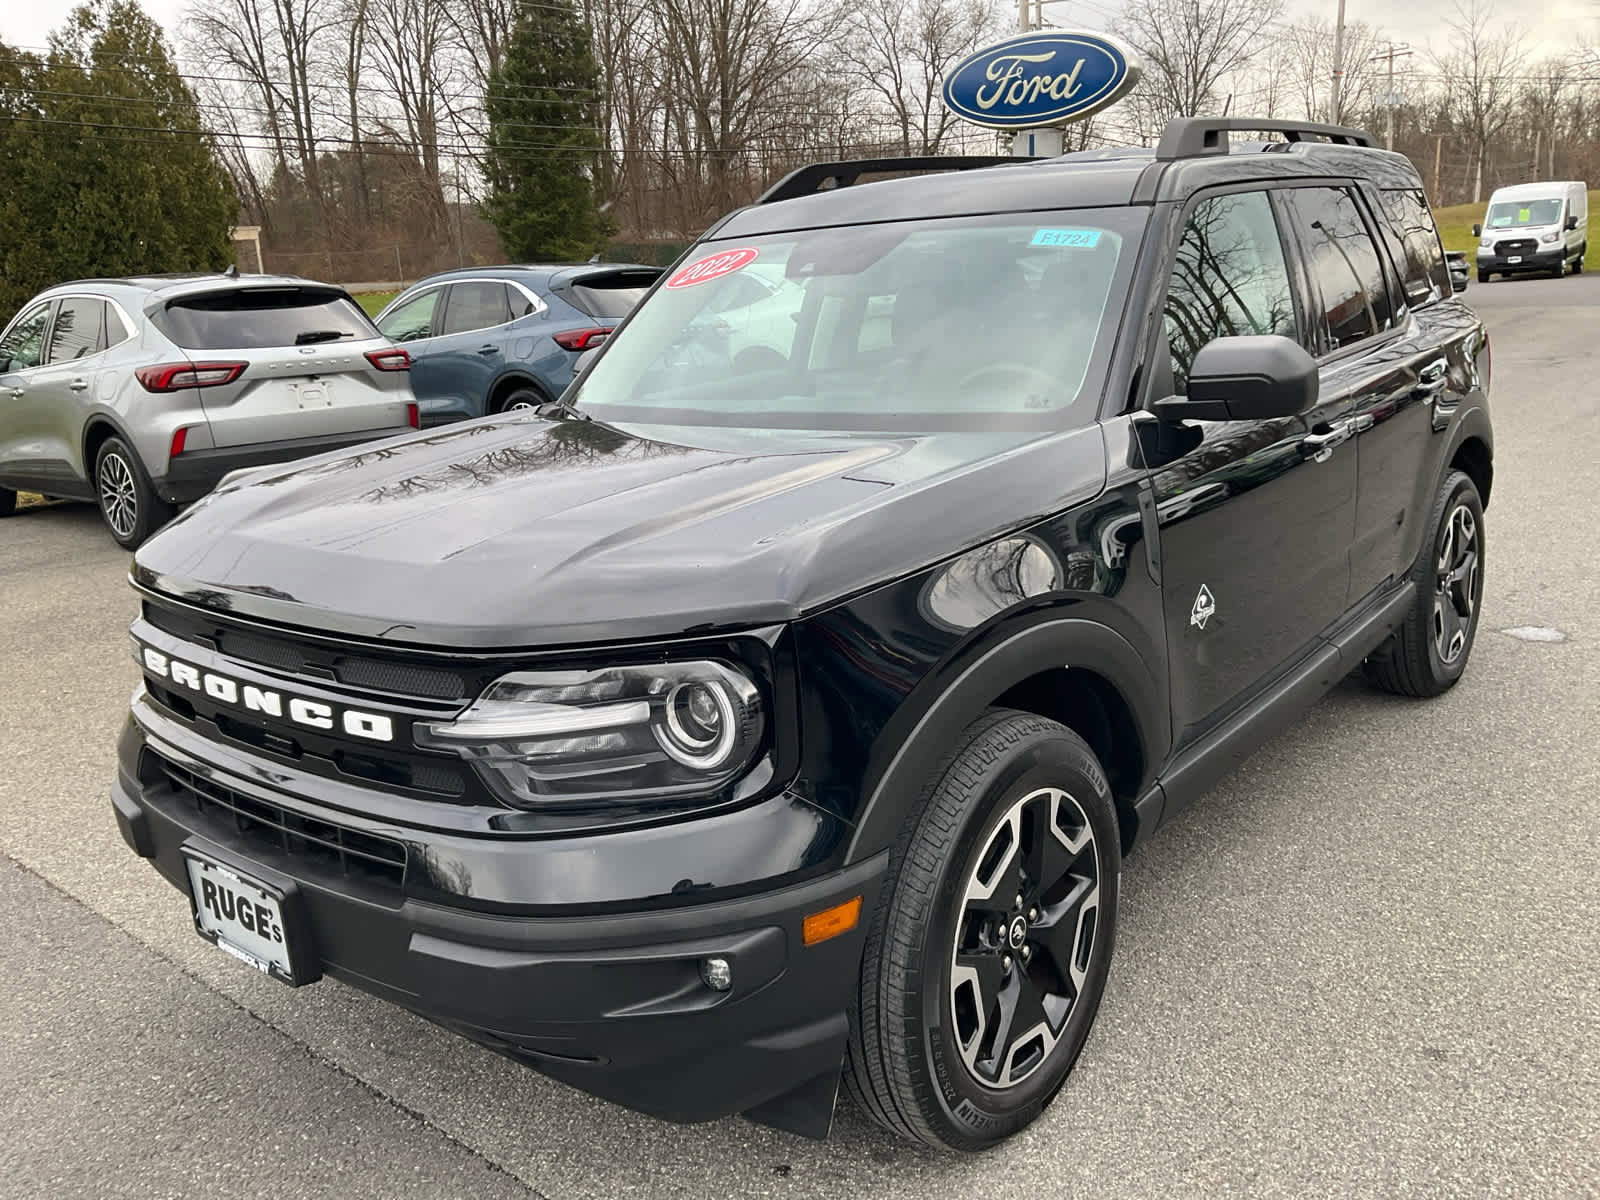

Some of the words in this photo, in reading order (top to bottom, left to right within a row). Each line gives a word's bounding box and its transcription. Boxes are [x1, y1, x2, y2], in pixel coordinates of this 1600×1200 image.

[976, 50, 1086, 110] Ford
[1040, 232, 1091, 245] F1724
[673, 251, 747, 286] 2022
[143, 647, 394, 742] BRONCO
